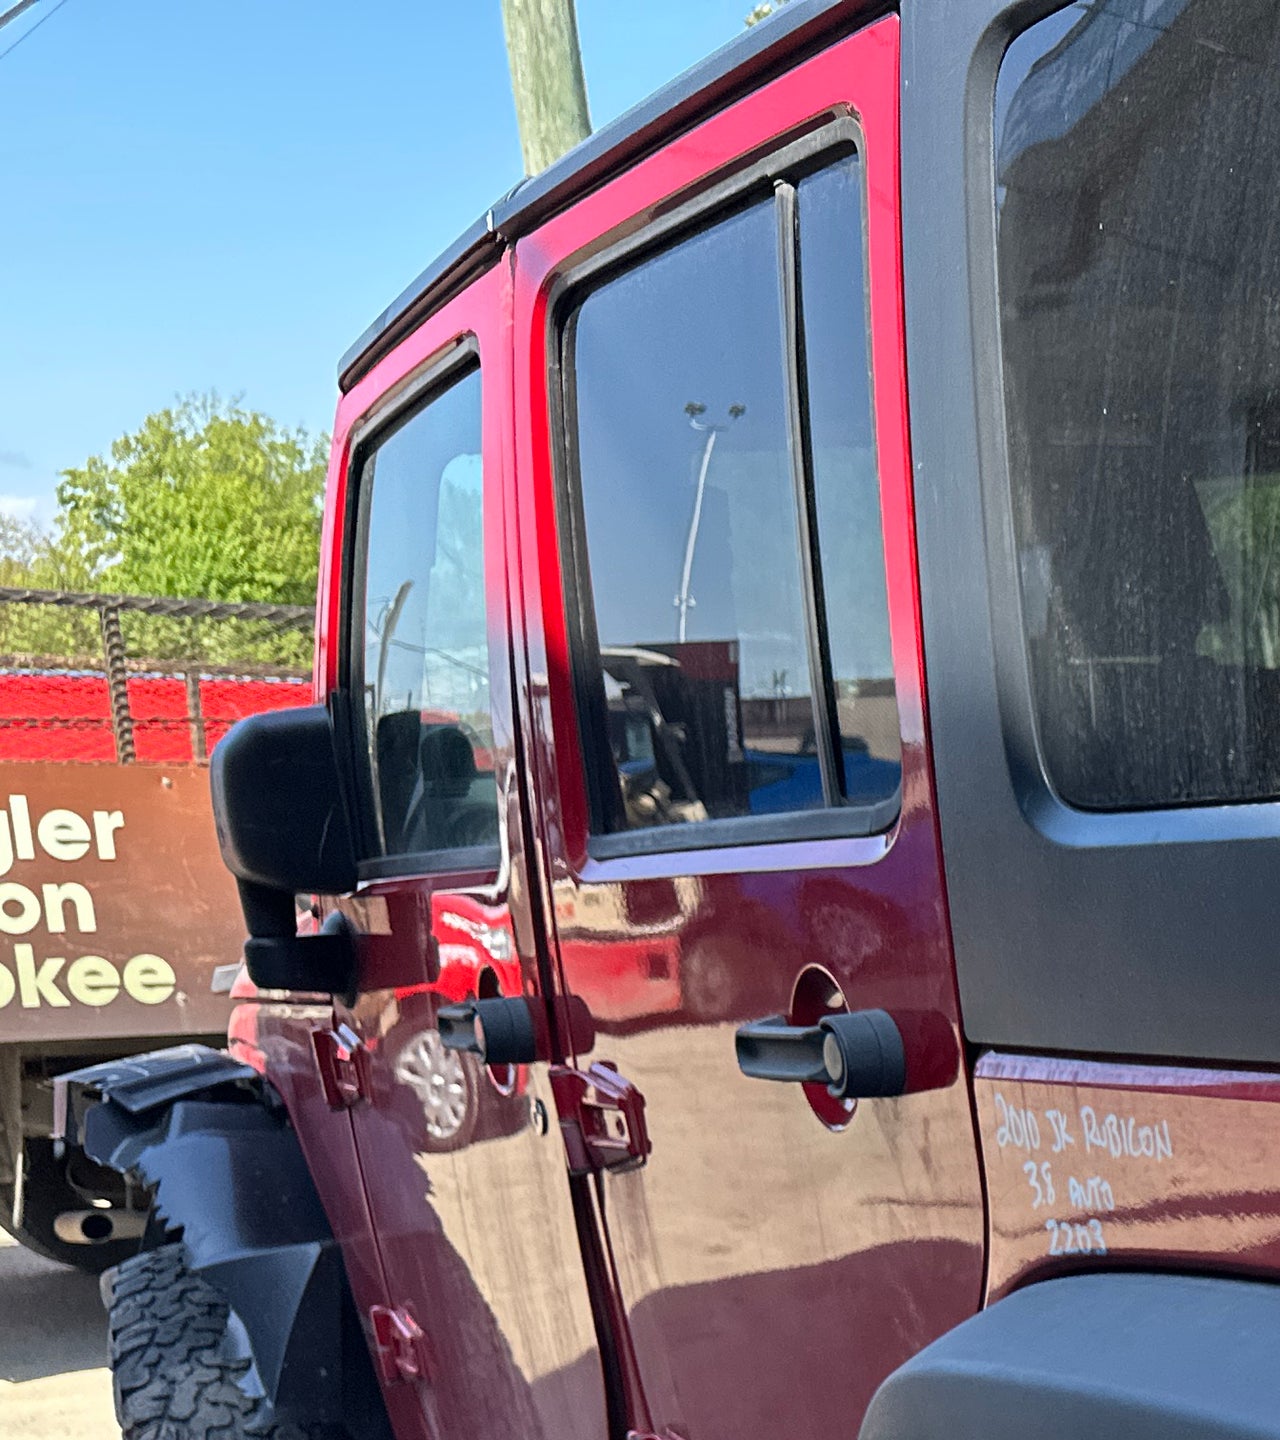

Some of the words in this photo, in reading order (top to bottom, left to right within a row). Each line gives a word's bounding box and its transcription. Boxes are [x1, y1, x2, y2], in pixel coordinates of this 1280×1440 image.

[0, 943, 176, 1010] kee
[994, 1092, 1041, 1153] 2010
[1045, 1108, 1075, 1153] JK
[1080, 1105, 1174, 1163] RUBICON
[1067, 1175, 1116, 1211] AUTO
